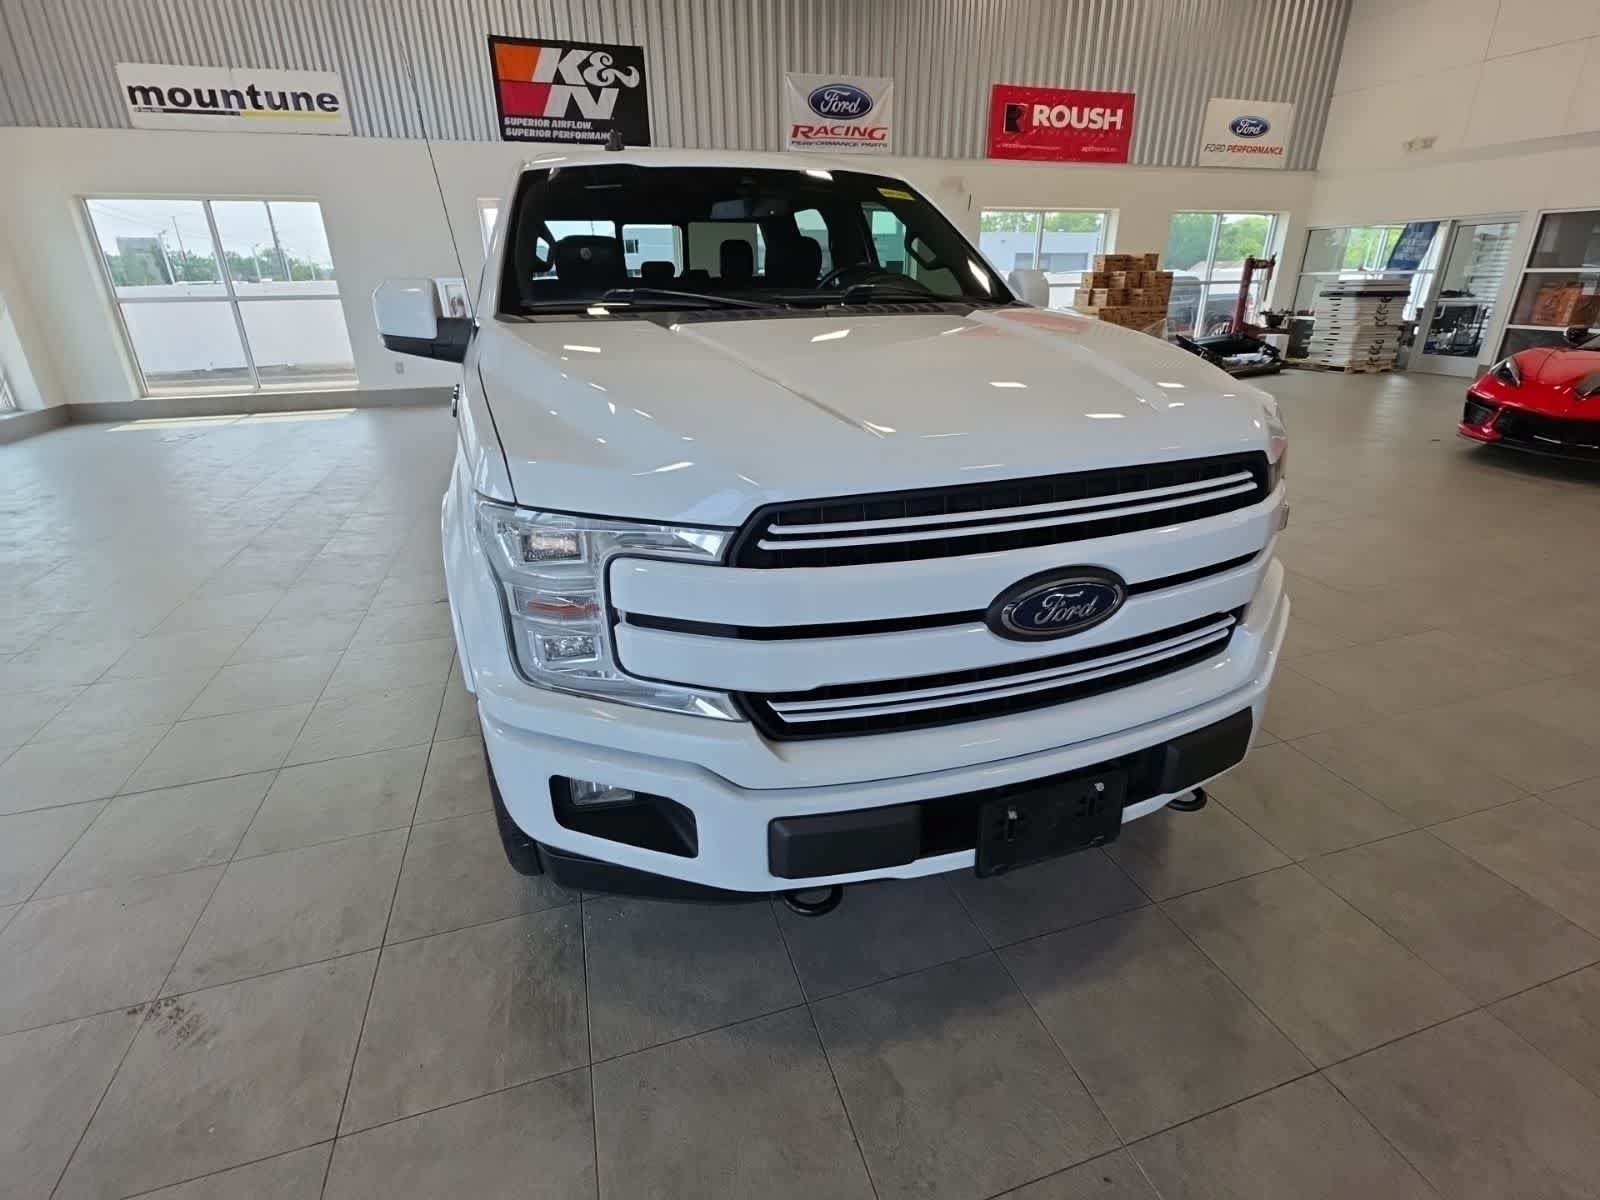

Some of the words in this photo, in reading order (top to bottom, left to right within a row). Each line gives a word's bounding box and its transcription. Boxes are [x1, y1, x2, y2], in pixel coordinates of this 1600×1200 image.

[127, 84, 339, 112] mountune
[820, 89, 861, 113] Ford
[504, 116, 550, 128] SUPERIOR
[551, 119, 593, 129] AIRFLOW.
[1032, 104, 1123, 130] ROUSH
[505, 127, 552, 138] SUPERIOR
[552, 130, 611, 140] PERFORMANC
[792, 124, 888, 140] RACING
[1236, 119, 1263, 135] Ford
[1204, 143, 1226, 153] FORD
[1226, 144, 1284, 155] PERFORMANCE
[1034, 590, 1098, 624] Ford
